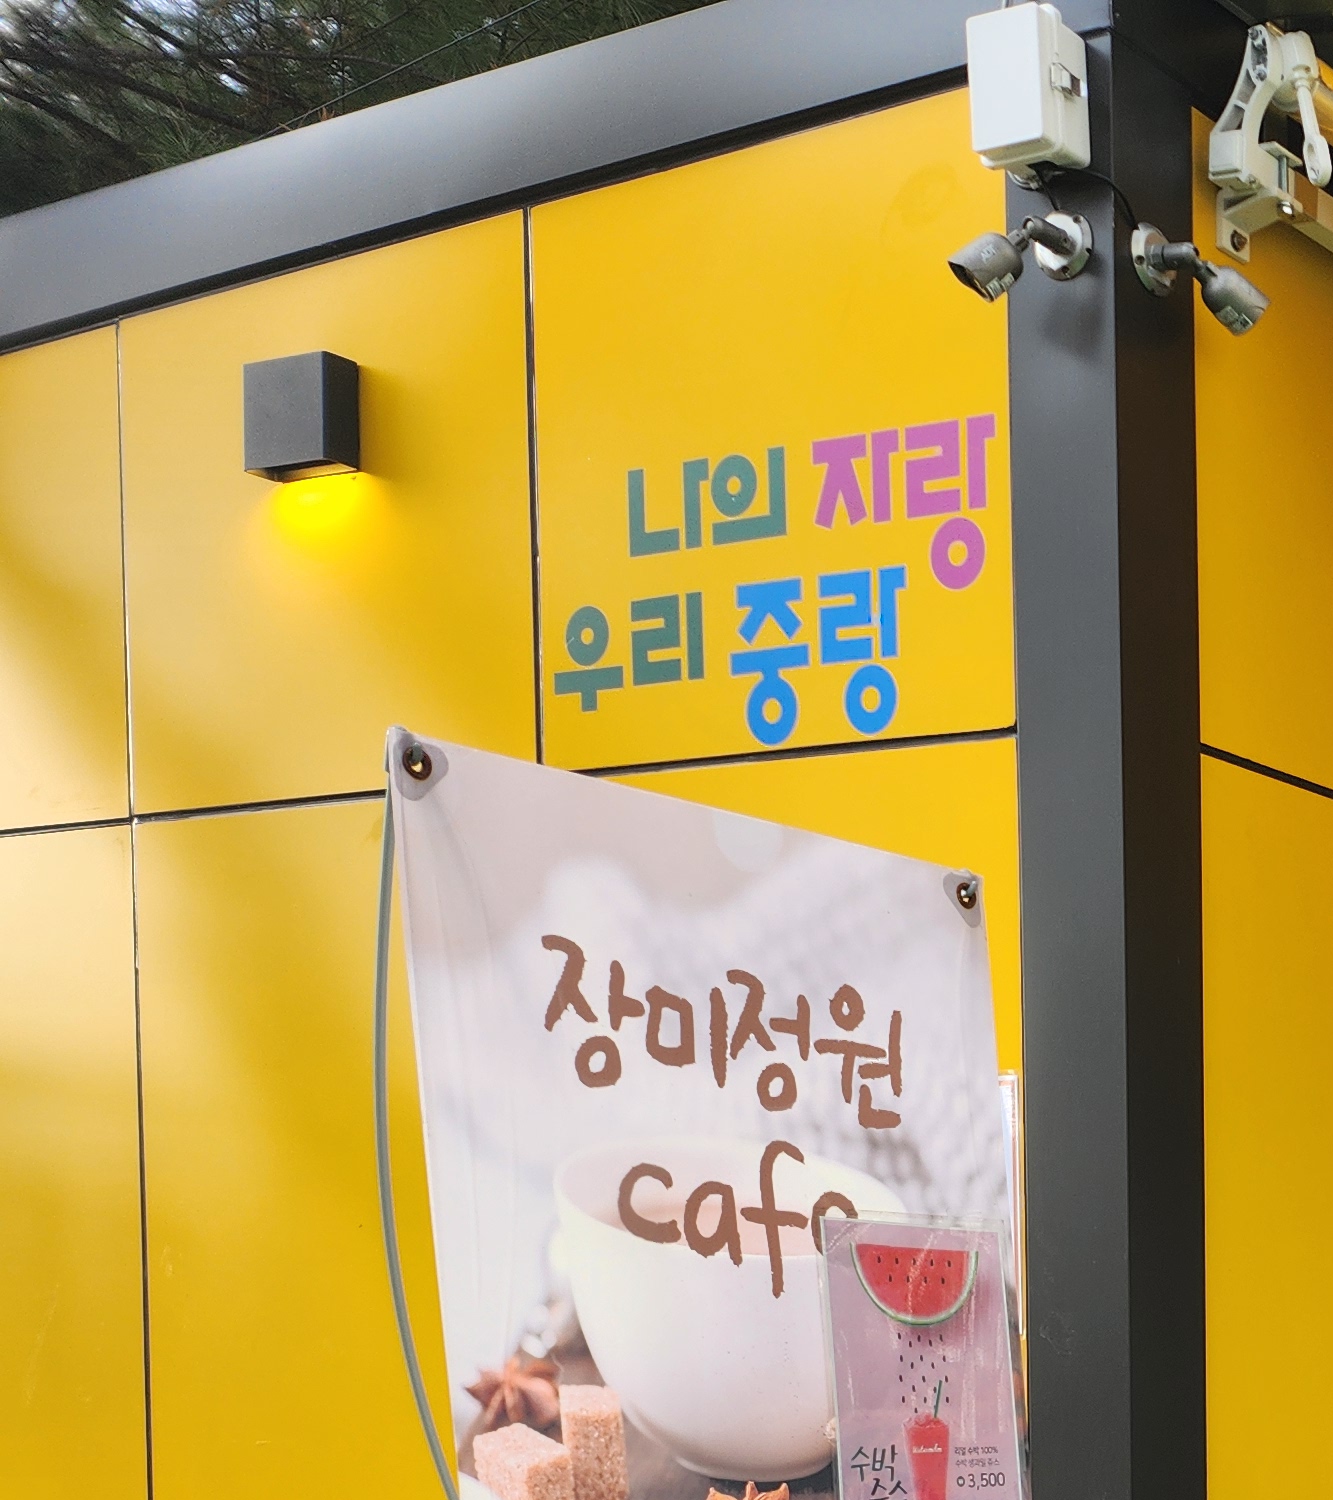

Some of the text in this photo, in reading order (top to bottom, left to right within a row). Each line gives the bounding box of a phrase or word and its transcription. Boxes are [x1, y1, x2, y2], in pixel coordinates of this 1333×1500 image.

[627, 413, 996, 591] 나의 자랑
[553, 564, 907, 747] 우리 중랑
[540, 934, 904, 1130] 장미정원
[850, 1444, 898, 1482] 수박
[955, 1458, 967, 1467] 수박
[967, 1446, 979, 1455] 수박
[980, 1446, 998, 1454] 100%
[967, 1471, 1005, 1491] 3,500
